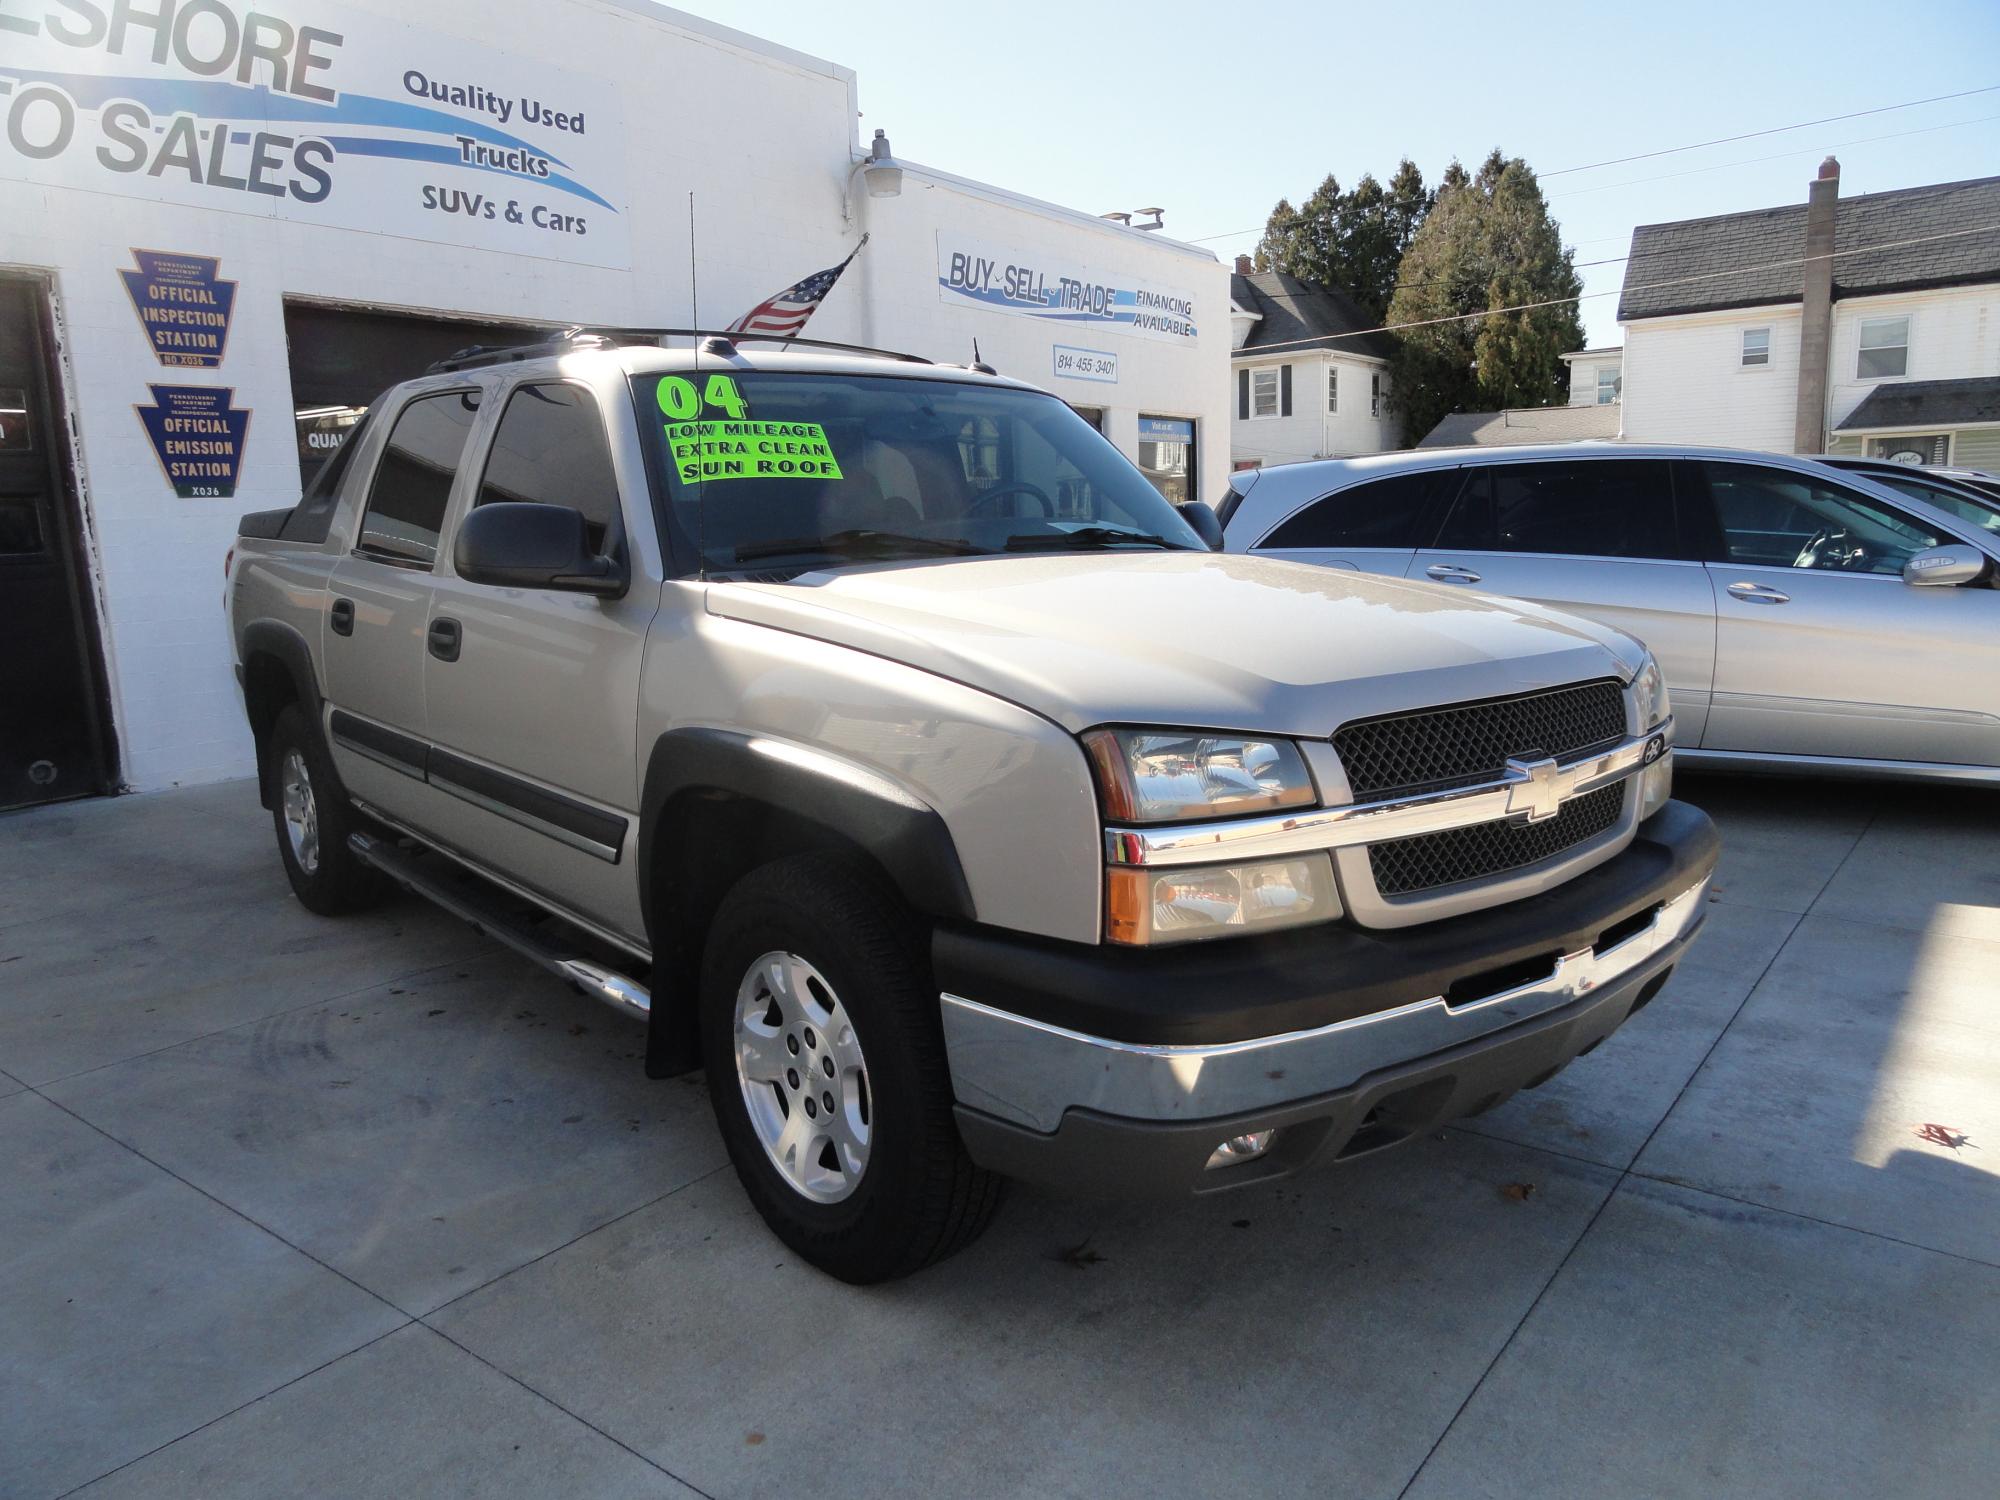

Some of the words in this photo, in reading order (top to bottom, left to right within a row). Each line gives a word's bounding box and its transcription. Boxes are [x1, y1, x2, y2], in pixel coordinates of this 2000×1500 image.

[403, 70, 513, 123] Quality
[521, 98, 585, 135] Used
[0, 78, 75, 160] O
[96, 102, 335, 203] SALES
[456, 136, 549, 177] Trucks
[422, 185, 496, 220] SUVs
[504, 200, 524, 225] &
[531, 205, 587, 235] Cars
[149, 284, 217, 305] OFFICIAL
[950, 252, 995, 292] BUY
[1003, 265, 1048, 304] SELL
[1060, 278, 1115, 317] TRADE
[1136, 290, 1192, 315] FINANCING
[143, 307, 225, 327] INSPECTION
[1133, 313, 1191, 337] AVAILABLE
[155, 330, 218, 348] STATION
[656, 374, 748, 420] 04
[164, 418, 231, 433] OFFICIAL
[669, 424, 714, 439] LOW
[724, 423, 820, 438] MILEAGE
[165, 441, 234, 455] EMISSION
[308, 433, 343, 448] QUA
[676, 442, 748, 458] EXTRA
[758, 441, 826, 456] CLEAN
[171, 462, 231, 477] STATION
[683, 461, 743, 479] SUN
[757, 460, 834, 474] ROOF
[192, 486, 220, 496] X036
